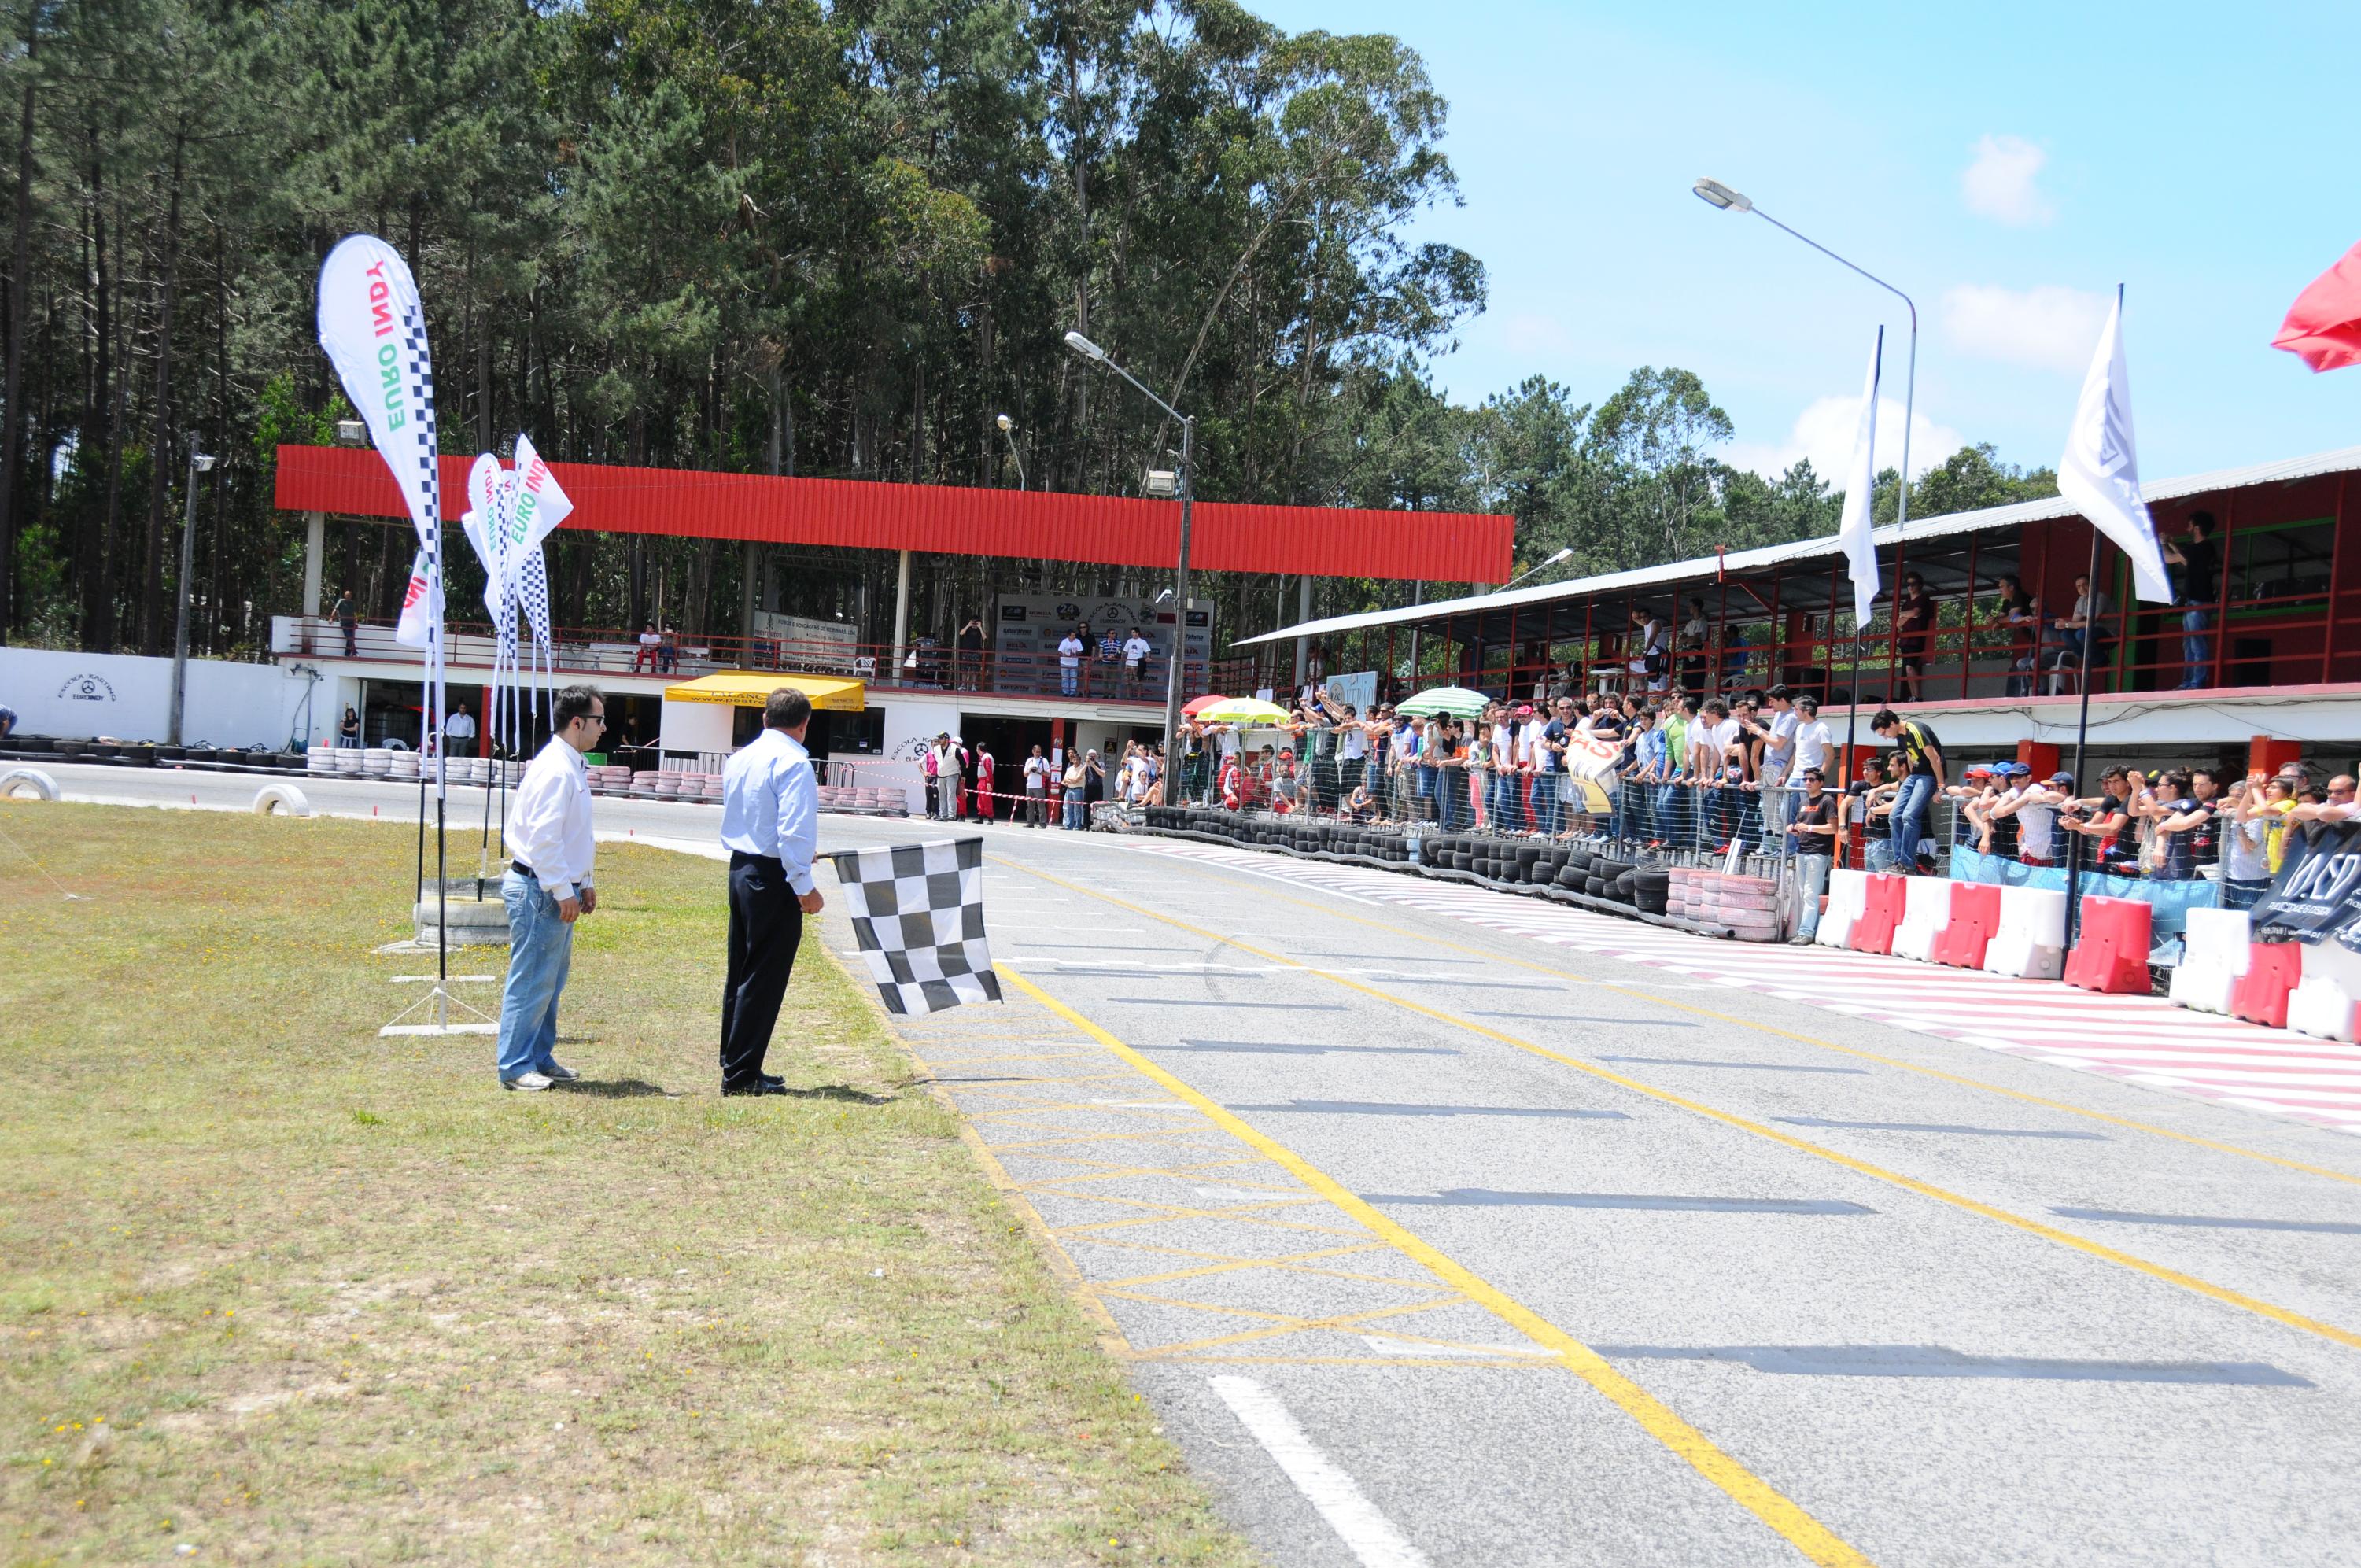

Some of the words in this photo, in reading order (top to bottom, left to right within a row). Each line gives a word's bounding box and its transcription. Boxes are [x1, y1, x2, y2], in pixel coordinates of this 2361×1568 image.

[511, 493, 537, 545] EURO
[526, 453, 547, 494] IND
[891, 737, 917, 761] ESCOLA
